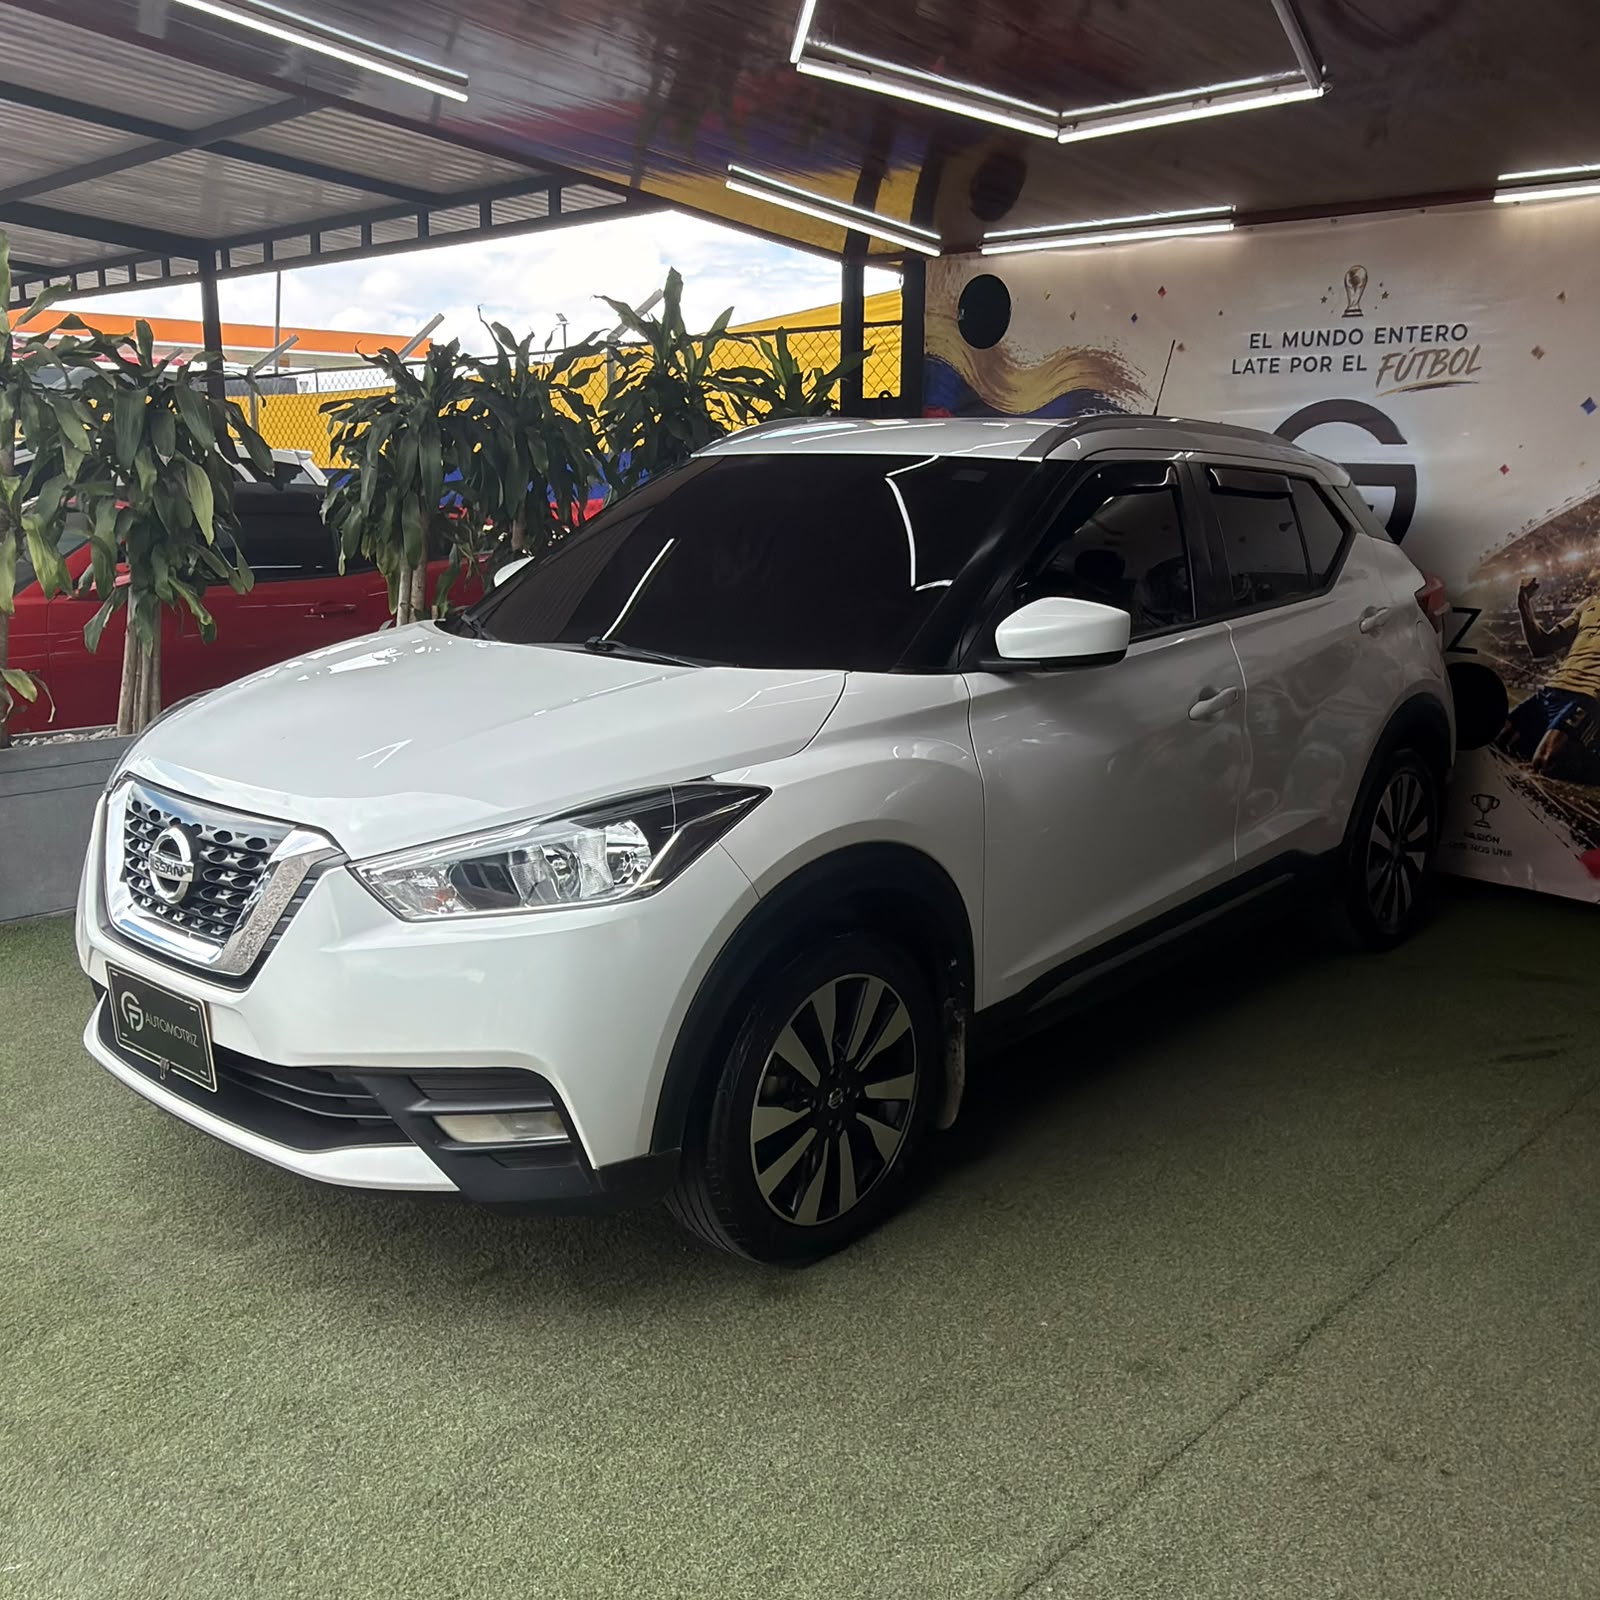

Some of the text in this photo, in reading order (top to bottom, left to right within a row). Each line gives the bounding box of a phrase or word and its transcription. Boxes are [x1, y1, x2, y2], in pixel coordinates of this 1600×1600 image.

[1249, 323, 1468, 349] EL MUNDO ENTERO
[1231, 344, 1482, 388] LATE POR EL FÚTBOL
[145, 1011, 199, 1048] AUTOMOTRIZ
